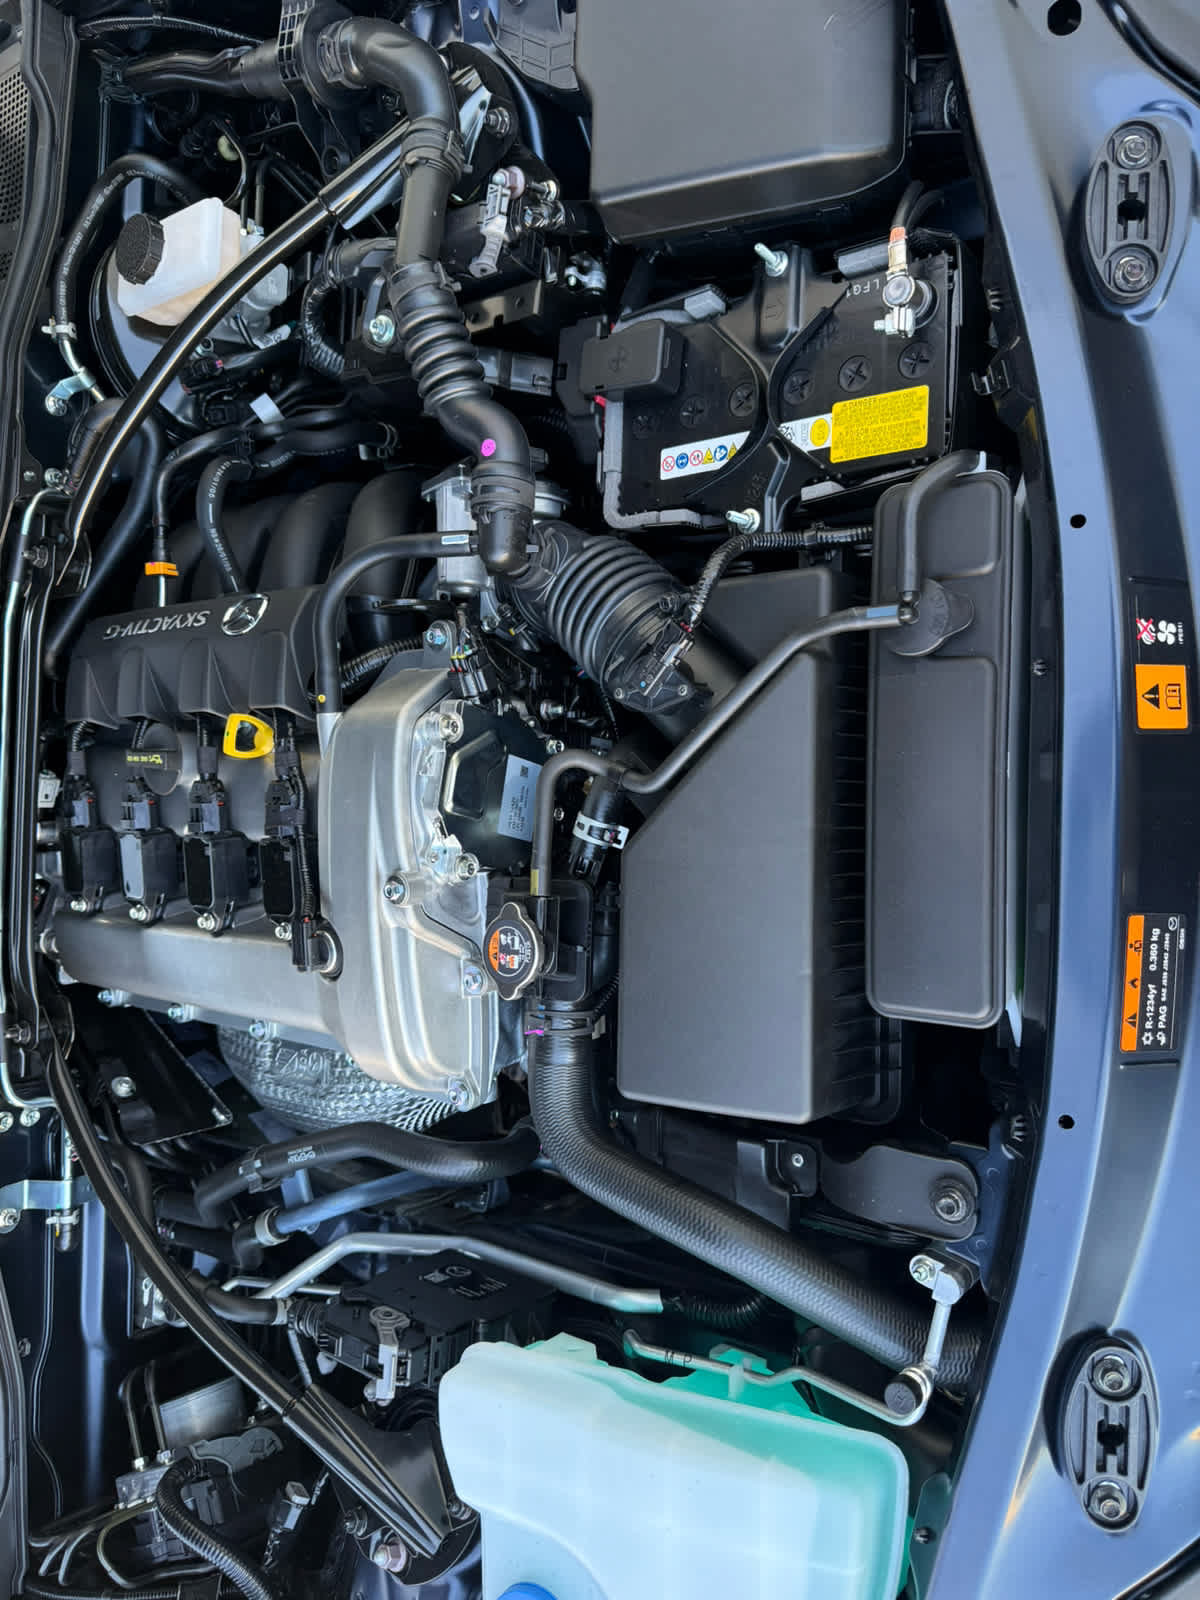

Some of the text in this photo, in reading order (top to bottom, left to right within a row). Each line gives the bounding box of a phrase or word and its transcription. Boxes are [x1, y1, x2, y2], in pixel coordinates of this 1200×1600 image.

[103, 610, 211, 640] SKYACTIV-G
[1151, 928, 1161, 942] kg
[1145, 984, 1158, 1029] R-1234yf
[1158, 1005, 1168, 1029] PAG
